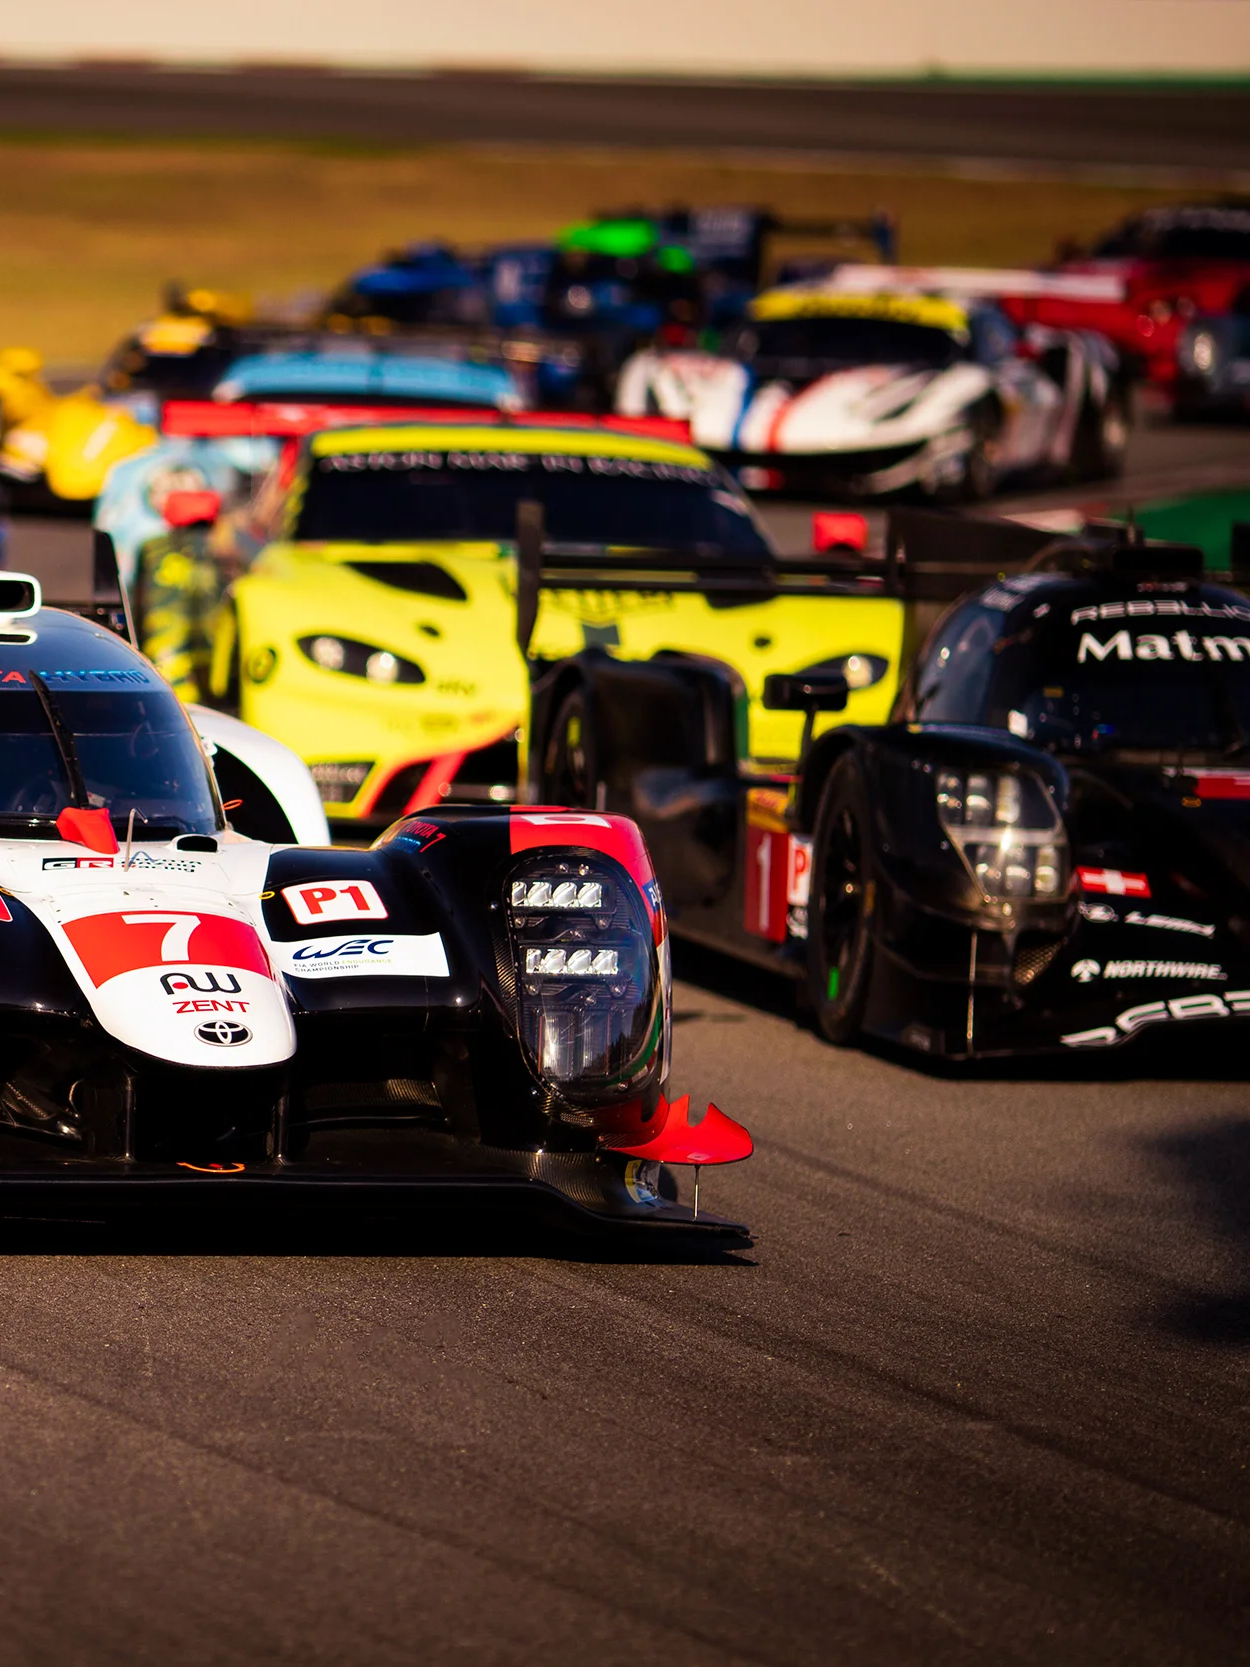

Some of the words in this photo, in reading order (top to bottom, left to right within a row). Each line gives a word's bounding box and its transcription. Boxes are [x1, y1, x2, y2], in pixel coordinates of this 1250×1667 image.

[1077, 629, 1250, 663] Matm
[39, 669, 151, 685] HYBRID
[419, 832, 447, 853] 7
[42, 857, 114, 870] GR
[794, 846, 808, 892] P
[756, 832, 772, 932] 1
[299, 886, 371, 914] P1
[122, 914, 201, 962] 7
[292, 939, 394, 960] WEC
[295, 964, 359, 972] CHAMPIONSHIP
[1103, 958, 1223, 980] NORTHWIRE
[172, 1000, 250, 1014] ZENT
